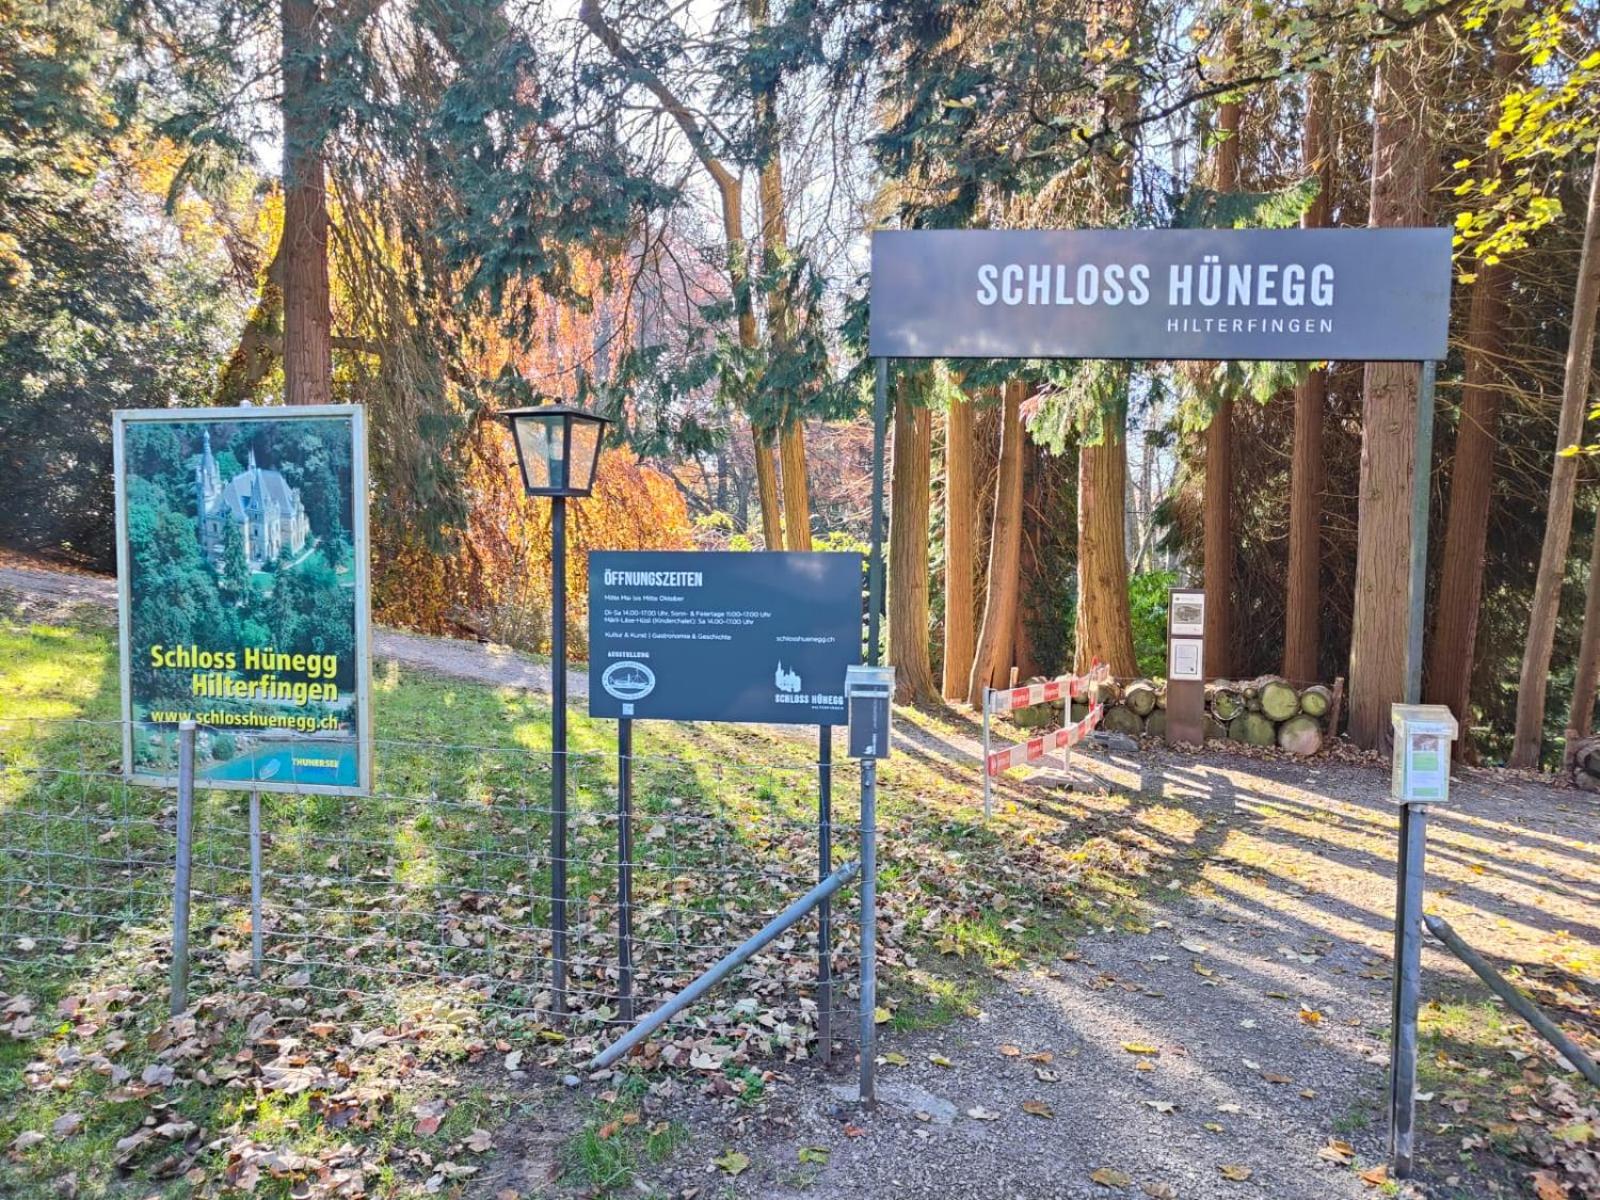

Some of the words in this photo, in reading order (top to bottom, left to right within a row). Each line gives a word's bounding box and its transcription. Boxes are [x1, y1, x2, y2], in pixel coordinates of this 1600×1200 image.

[976, 264, 1150, 306] SCHLOSS
[1168, 255, 1335, 307] HÜNEGG
[1167, 319, 1334, 333] HILTERFINGEN
[604, 568, 703, 587] ÖFFNUNGSZEITEN
[151, 644, 236, 670] Schloss
[245, 647, 337, 678] Hünegg
[192, 673, 338, 706] Hilterfingen
[775, 693, 809, 704] SCHLOSS
[811, 692, 844, 705] HÜNEGG
[151, 709, 338, 731] wwwschlosshuenegg.ch
